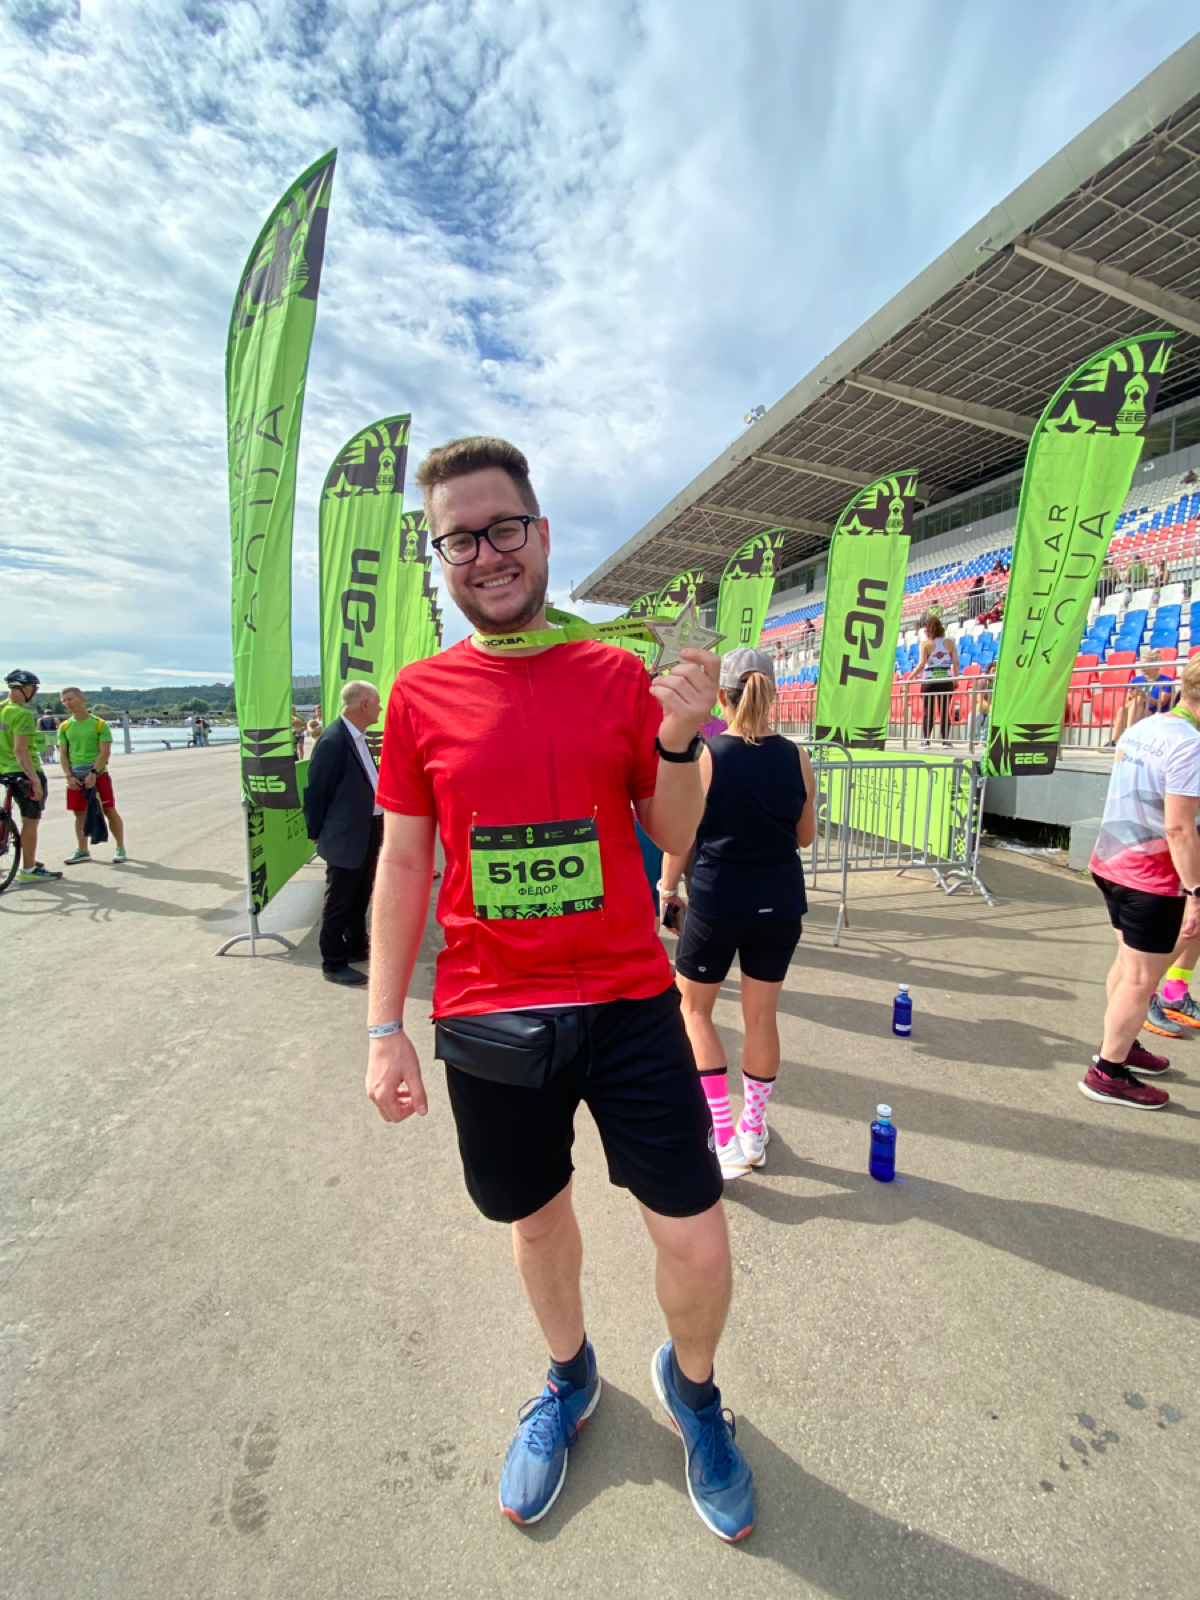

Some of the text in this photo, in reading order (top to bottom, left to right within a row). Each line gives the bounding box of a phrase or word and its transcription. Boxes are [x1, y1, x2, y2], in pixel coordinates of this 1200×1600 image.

[1015, 504, 1069, 669] STELLAR
[480, 636, 526, 647] ОСКВА
[286, 817, 307, 841] AQU
[488, 855, 585, 885] 5160
[574, 899, 596, 911] 5K
